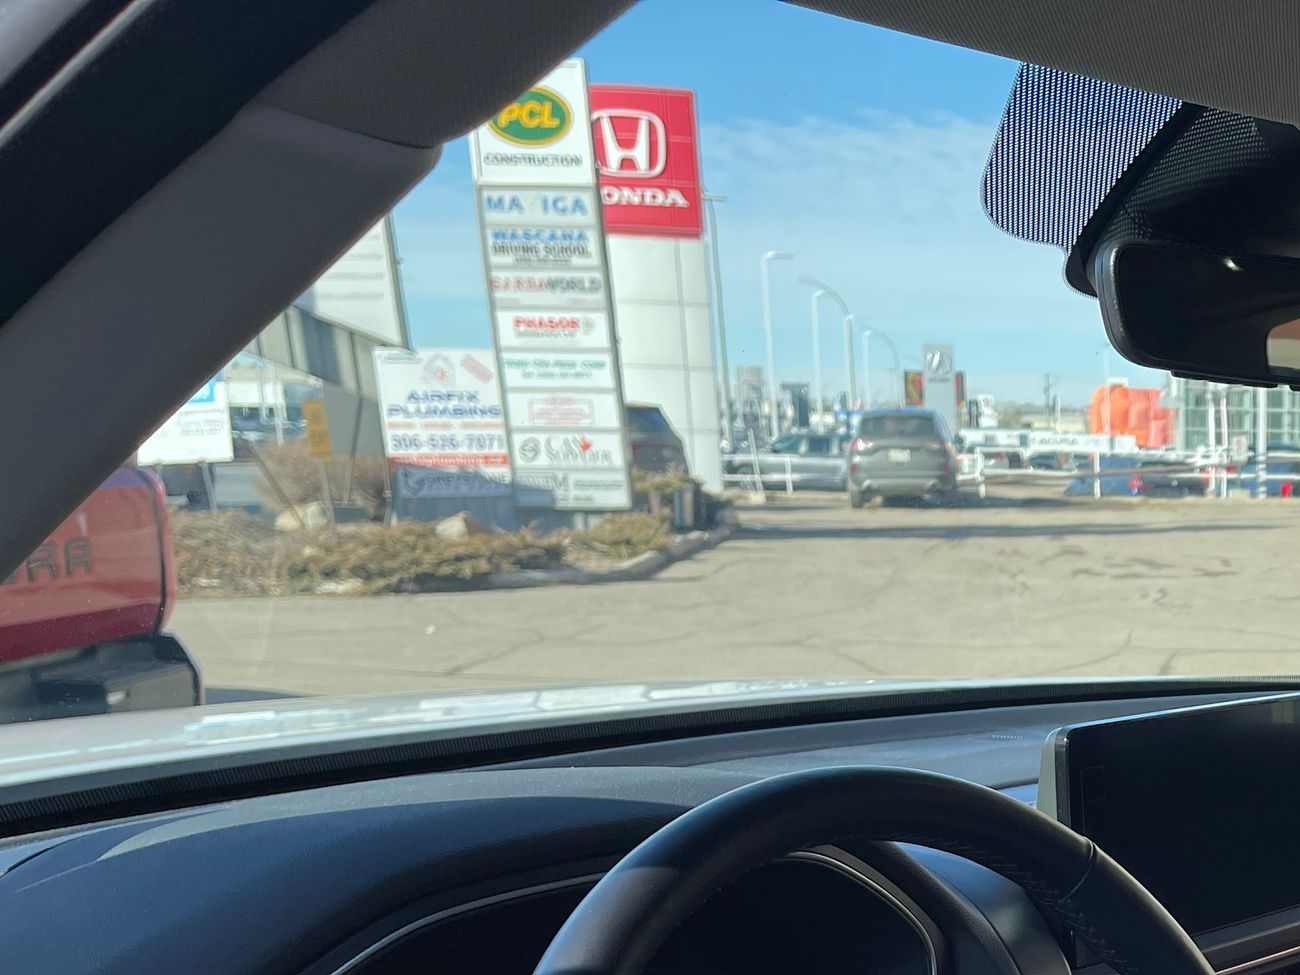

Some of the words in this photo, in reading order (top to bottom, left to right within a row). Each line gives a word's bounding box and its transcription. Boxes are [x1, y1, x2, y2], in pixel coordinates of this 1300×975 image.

[498, 101, 560, 128] PCL
[483, 152, 583, 167] CONSTRUCTION
[601, 186, 690, 208] ONDA
